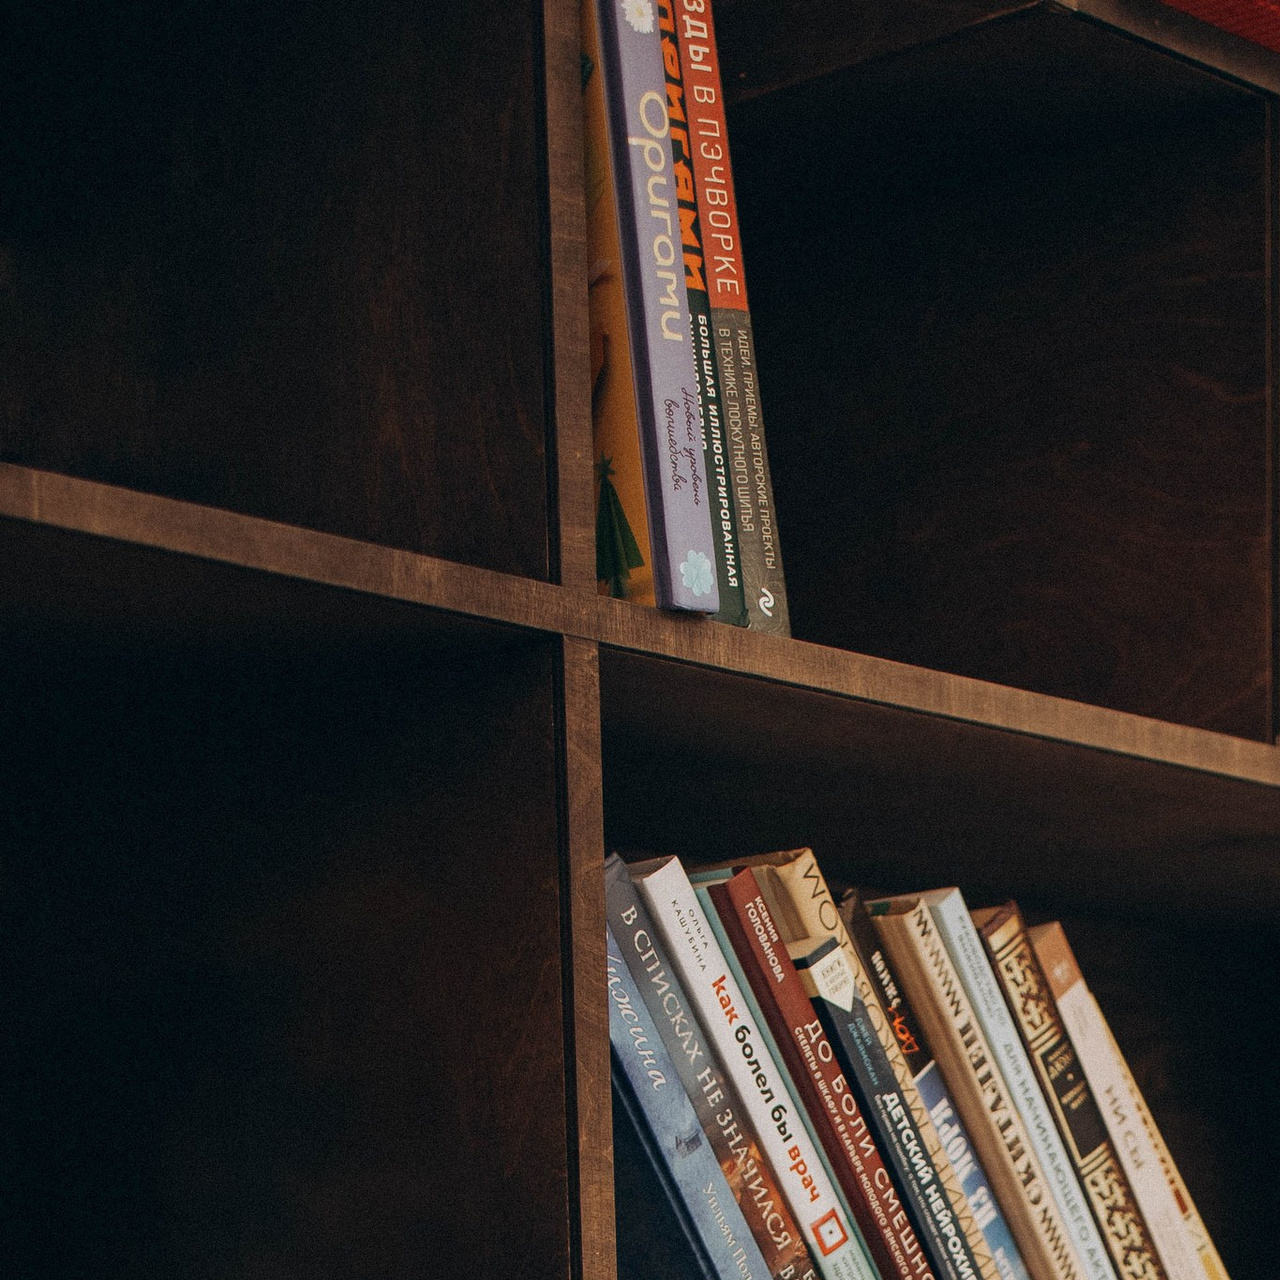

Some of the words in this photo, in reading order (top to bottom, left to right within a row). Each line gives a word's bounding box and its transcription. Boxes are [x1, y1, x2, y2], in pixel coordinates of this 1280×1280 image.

[693, 84, 714, 105] В
[623, 90, 682, 342] Оригами
[696, 117, 738, 296] ПЭЧВОРКЕ
[718, 327, 729, 336] В
[720, 339, 737, 397] ТЕХНИКЕ
[681, 386, 697, 441] Новый
[727, 399, 748, 484] ЛОСКУТНОГО
[683, 447, 703, 506] уровень
[697, 314, 716, 397] БОЛЬШАЯ
[707, 404, 738, 587] ИЛЛЮСТРИРОВАННАЯ
[738, 484, 753, 531] ШИТЬЯ
[670, 899, 707, 972] КАШУБИНА
[687, 908, 709, 949] ОЛЬГА
[744, 902, 786, 982] ГОЛОВАНОВА
[753, 895, 779, 942] КСЕНИЯ
[709, 974, 744, 1025] как
[619, 905, 640, 926] В
[630, 928, 704, 1065] СПИСКАХ
[695, 1065, 728, 1113] НЕ
[715, 1108, 793, 1250] ЗНАЧИЛСЯ
[732, 1023, 779, 1103] болел
[803, 1018, 834, 1065] ДО
[830, 1074, 877, 1157] БОЛИ
[768, 1103, 797, 1142] бы
[881, 1091, 936, 1184] ДЕТСКИЙ
[782, 1144, 821, 1204] врач
[701, 1183, 738, 1247] Уильям
